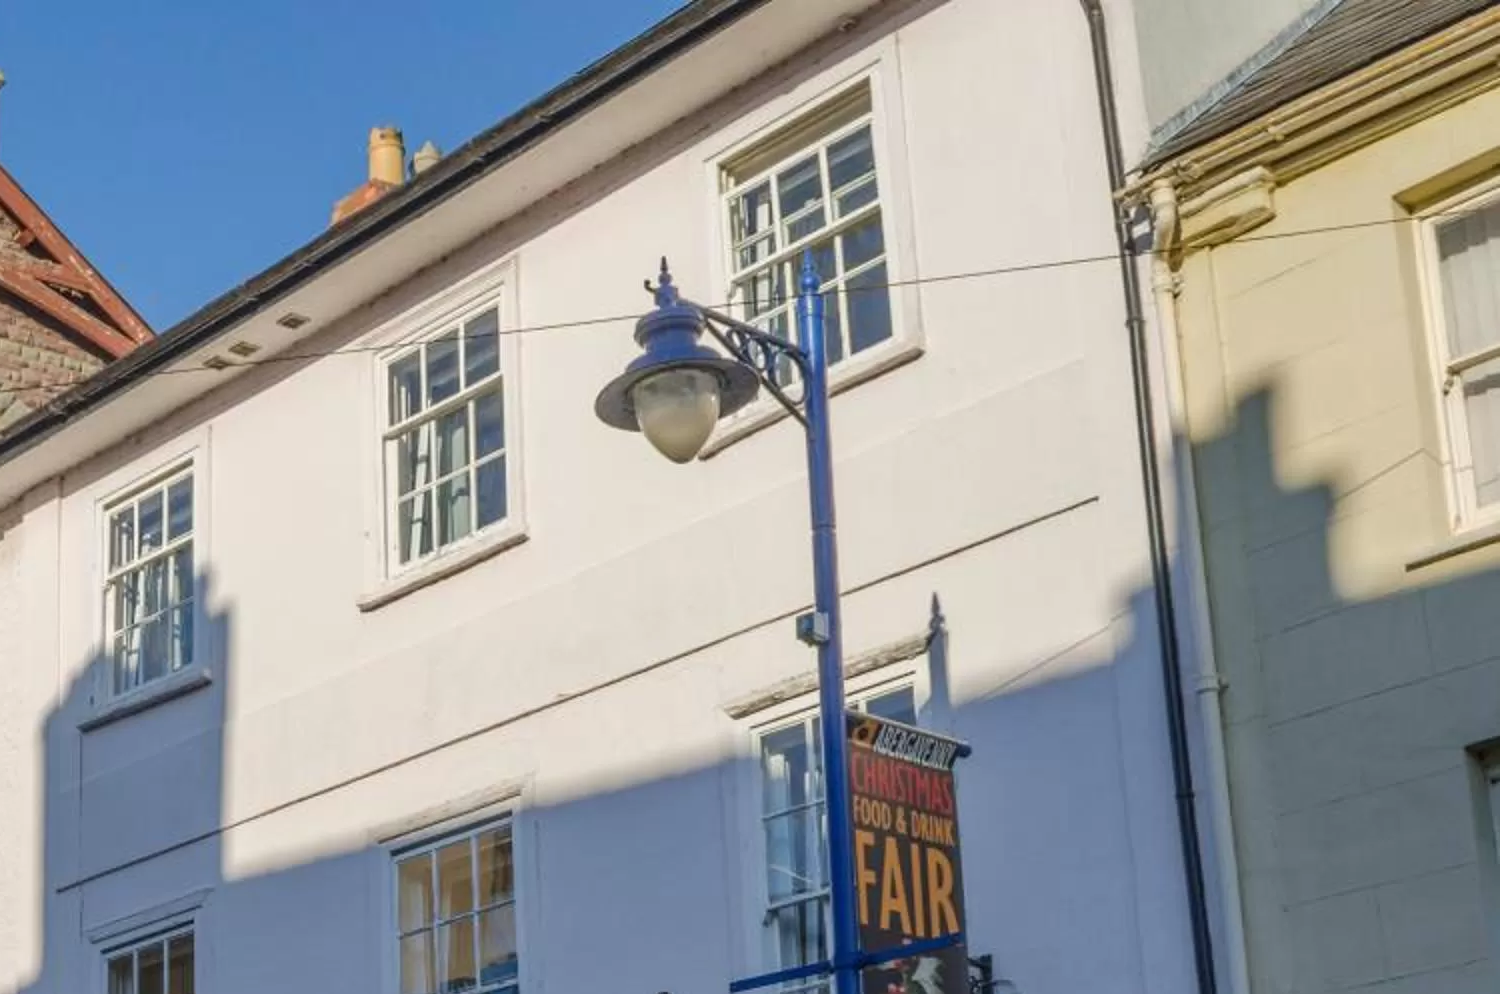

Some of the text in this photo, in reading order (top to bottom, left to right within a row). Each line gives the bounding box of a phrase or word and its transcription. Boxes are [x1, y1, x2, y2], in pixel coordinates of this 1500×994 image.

[850, 748, 954, 819] CHRISTMAS
[852, 795, 956, 847] FOOD & DRINK
[855, 829, 961, 939] FAIR
